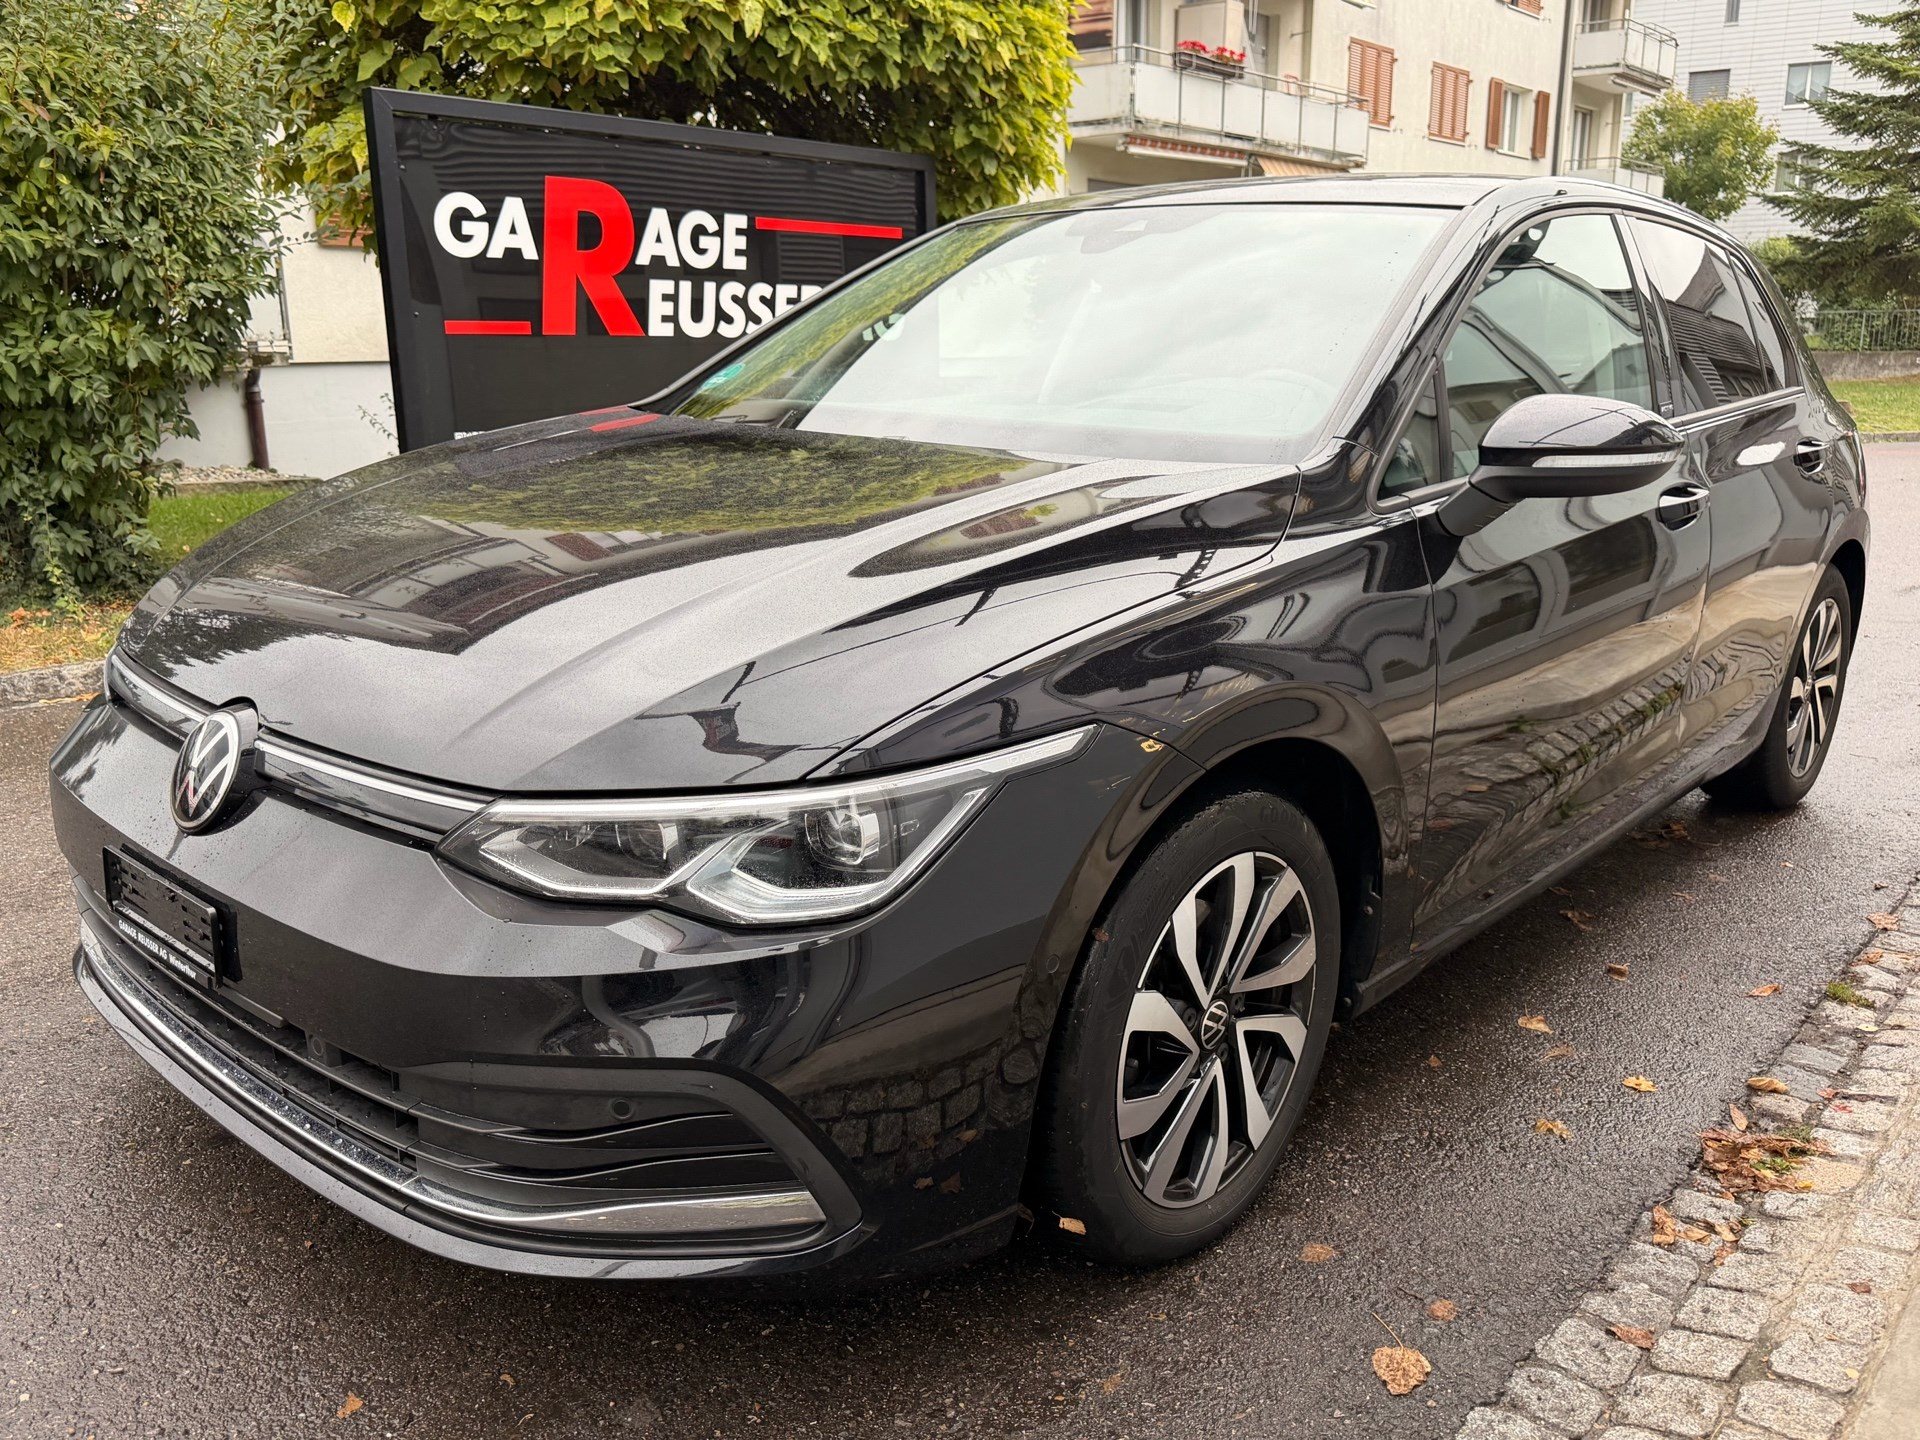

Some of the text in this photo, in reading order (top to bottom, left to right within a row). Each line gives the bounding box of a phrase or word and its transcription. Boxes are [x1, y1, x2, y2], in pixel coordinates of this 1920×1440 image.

[433, 174, 749, 337] GARAGE
[118, 919, 138, 940] GARAGE
[137, 932, 159, 955] REUSSER
[159, 947, 168, 960] AG
